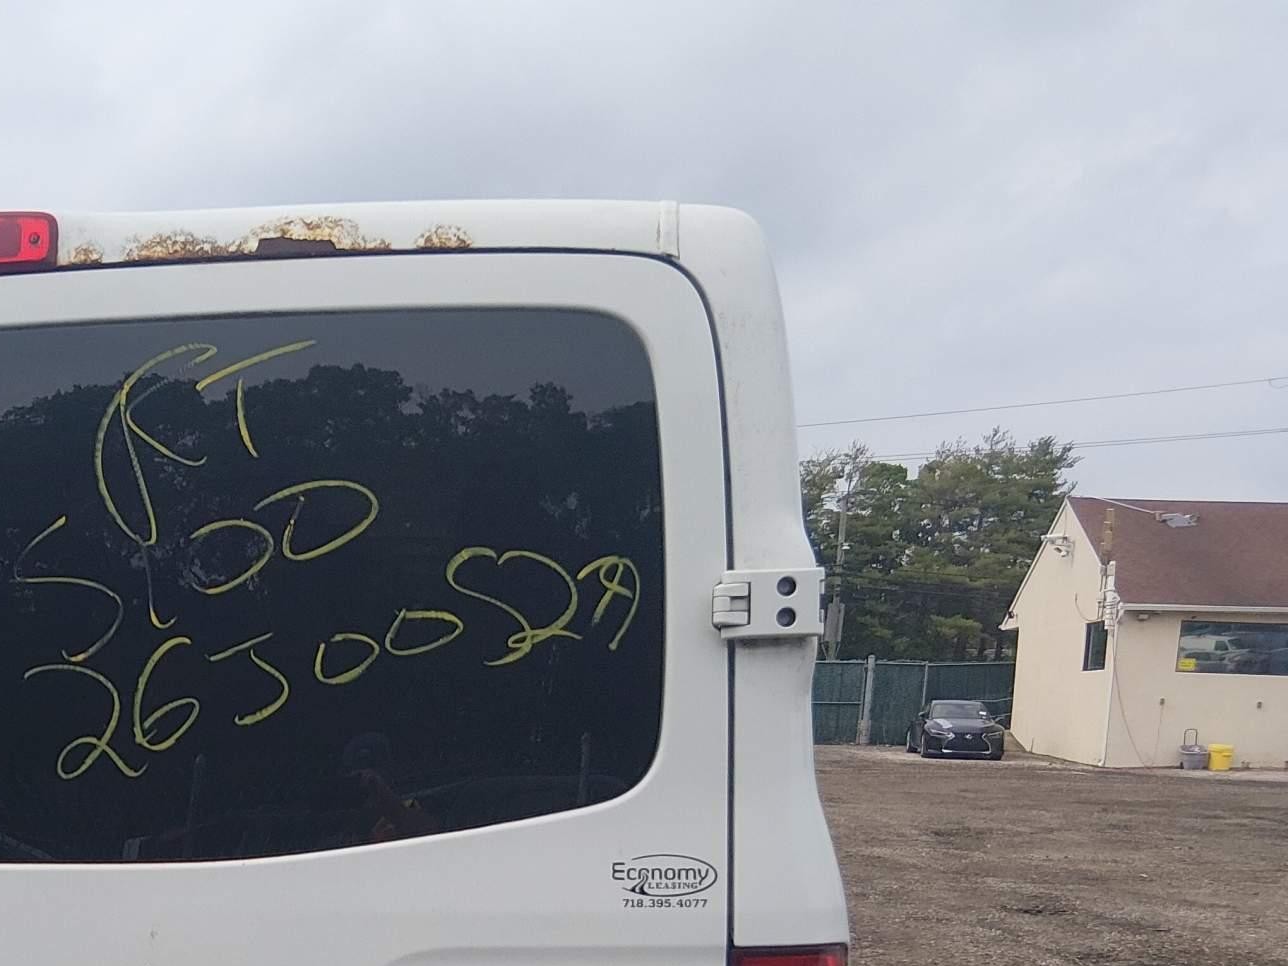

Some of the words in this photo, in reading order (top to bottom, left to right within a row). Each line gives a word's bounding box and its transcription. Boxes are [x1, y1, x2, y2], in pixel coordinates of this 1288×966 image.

[612, 862, 709, 885] Economy
[647, 881, 699, 890] LEASING
[622, 898, 708, 908] 718.395.4077
